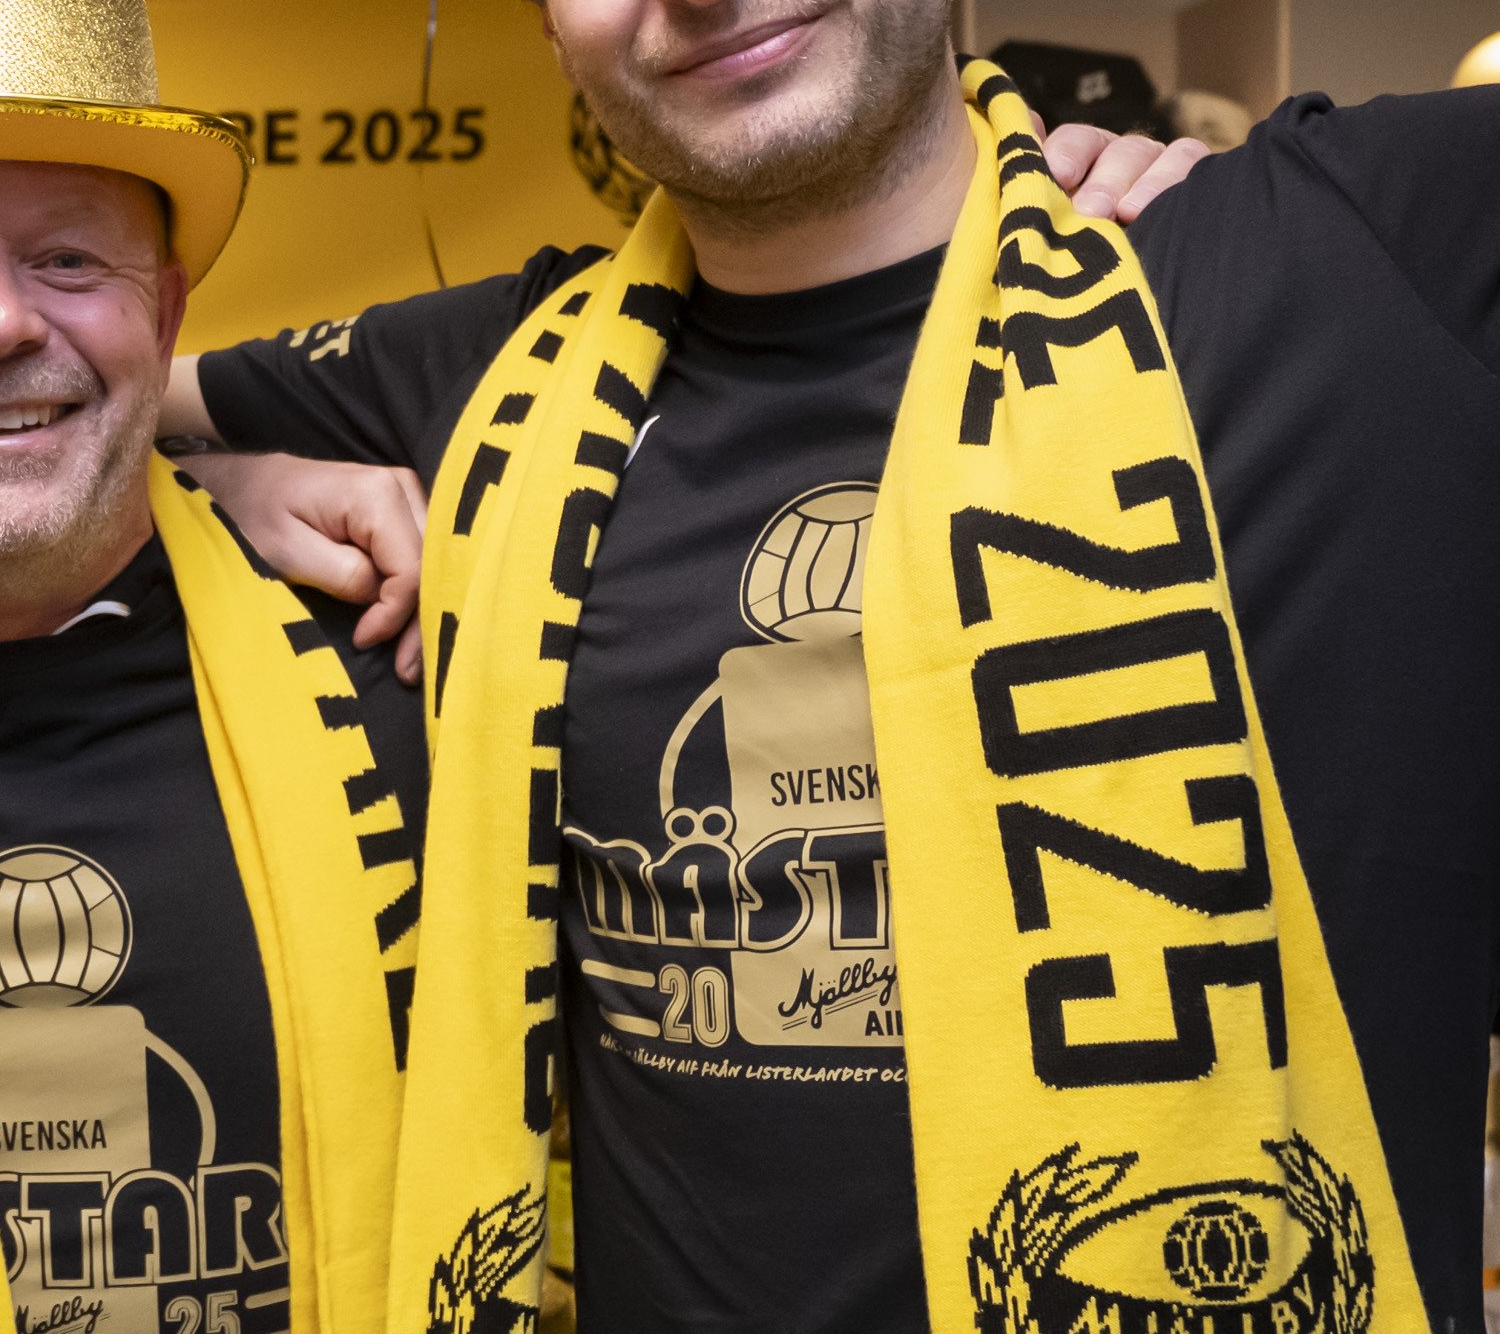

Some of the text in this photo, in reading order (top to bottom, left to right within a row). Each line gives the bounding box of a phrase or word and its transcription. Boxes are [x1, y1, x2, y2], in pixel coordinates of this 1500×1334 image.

[320, 107, 487, 164] 2025
[770, 763, 880, 807] SVENSK
[950, 455, 1288, 1090] 2025
[563, 806, 889, 952] MÄST
[659, 963, 730, 1048] 20
[778, 957, 898, 1029] Mjällby
[677, 1059, 699, 1075] AIF
[701, 1059, 742, 1078] FRÅN
[745, 1064, 878, 1082] LISTERLANDET
[881, 1067, 908, 1082] OC
